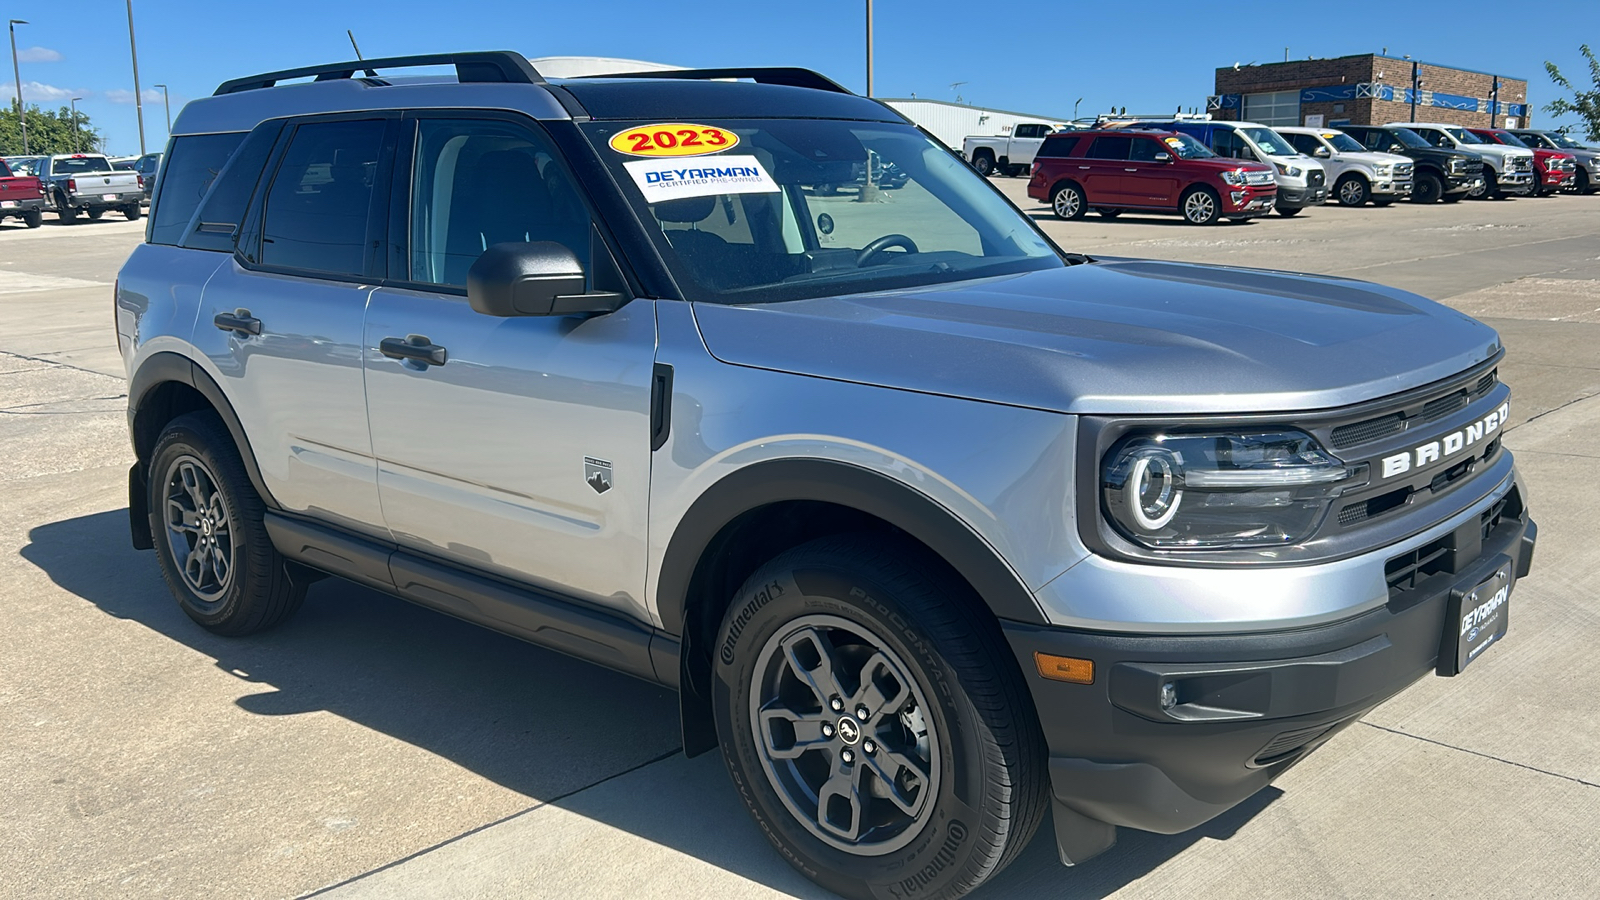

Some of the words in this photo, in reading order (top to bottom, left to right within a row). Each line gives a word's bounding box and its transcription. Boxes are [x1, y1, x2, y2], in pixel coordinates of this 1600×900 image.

[627, 129, 729, 152] 2023
[645, 167, 759, 183] DEYARMAN
[659, 178, 708, 188] CERTIFIED
[710, 176, 763, 184] PRE-OWNED
[1381, 403, 1509, 479] BRONCO
[721, 583, 774, 665] Continental
[897, 818, 969, 897] Continental
